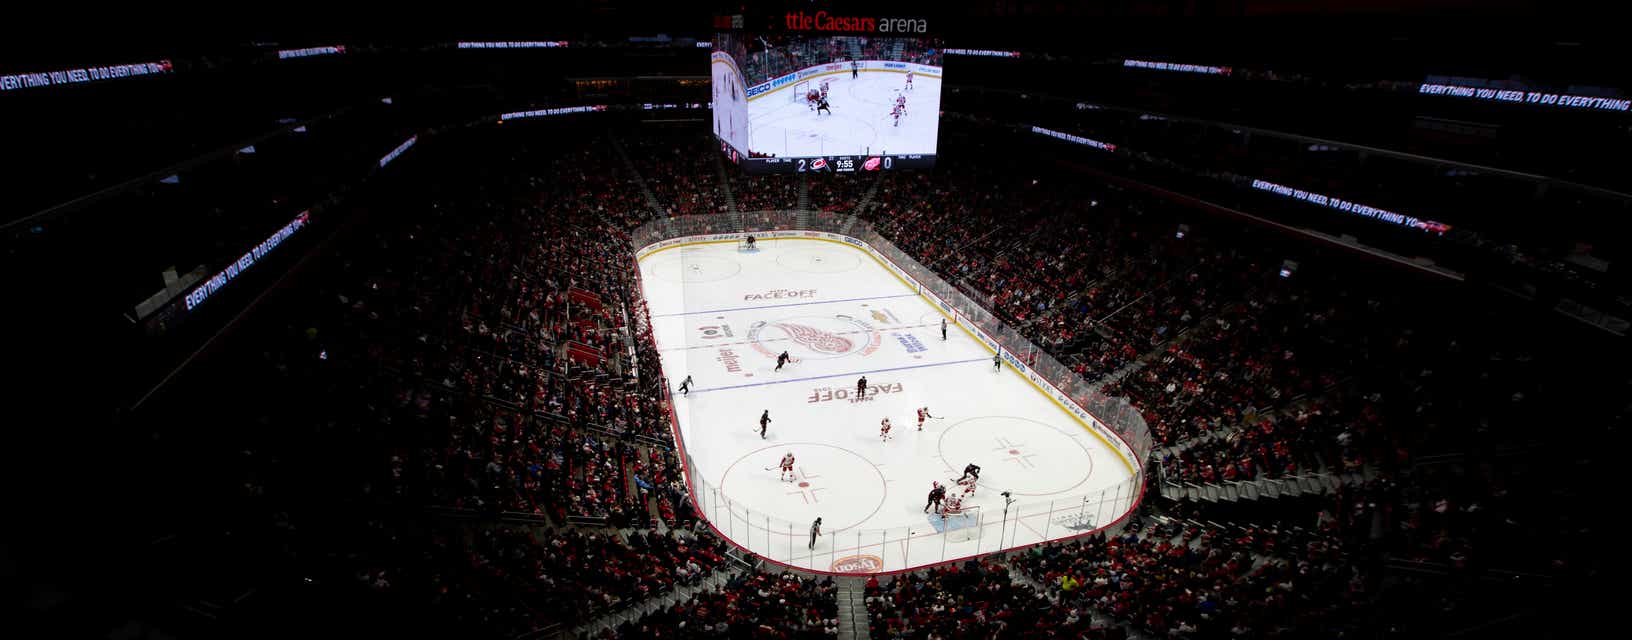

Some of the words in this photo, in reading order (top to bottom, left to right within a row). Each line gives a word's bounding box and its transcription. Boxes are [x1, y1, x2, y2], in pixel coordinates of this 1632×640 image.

[786, 11, 813, 30] ttle
[815, 10, 875, 31] Caesars
[879, 17, 927, 32] arena
[0, 72, 49, 90] VERYTHING
[49, 71, 66, 84] YOU
[89, 68, 99, 80] TO
[99, 67, 110, 79] DO
[110, 62, 148, 78] EVERYTHING
[1419, 83, 1475, 98] EVERYTHING
[1476, 88, 1496, 99] YOU
[1496, 89, 1524, 103] NEED,
[1526, 91, 1541, 103] TO
[1541, 94, 1556, 105] DO
[1557, 95, 1631, 111] EVERYTHING
[798, 159, 806, 172] 2
[836, 160, 853, 168] 9:55
[884, 157, 891, 169] 0
[1252, 179, 1292, 196] EVERYTHING
[1293, 188, 1307, 200] YOU
[1308, 192, 1328, 206] NEED,
[1329, 197, 1340, 208] TO
[1340, 200, 1352, 211] DO
[1352, 203, 1403, 224] EVERYTHING
[1405, 215, 1418, 227] YO
[185, 271, 227, 310] EVERYTHING
[225, 262, 239, 280] YOU
[252, 245, 260, 260] TO
[260, 241, 268, 256] DO
[267, 223, 294, 250] EVERYTHING
[808, 382, 903, 403] FAC-OFF
